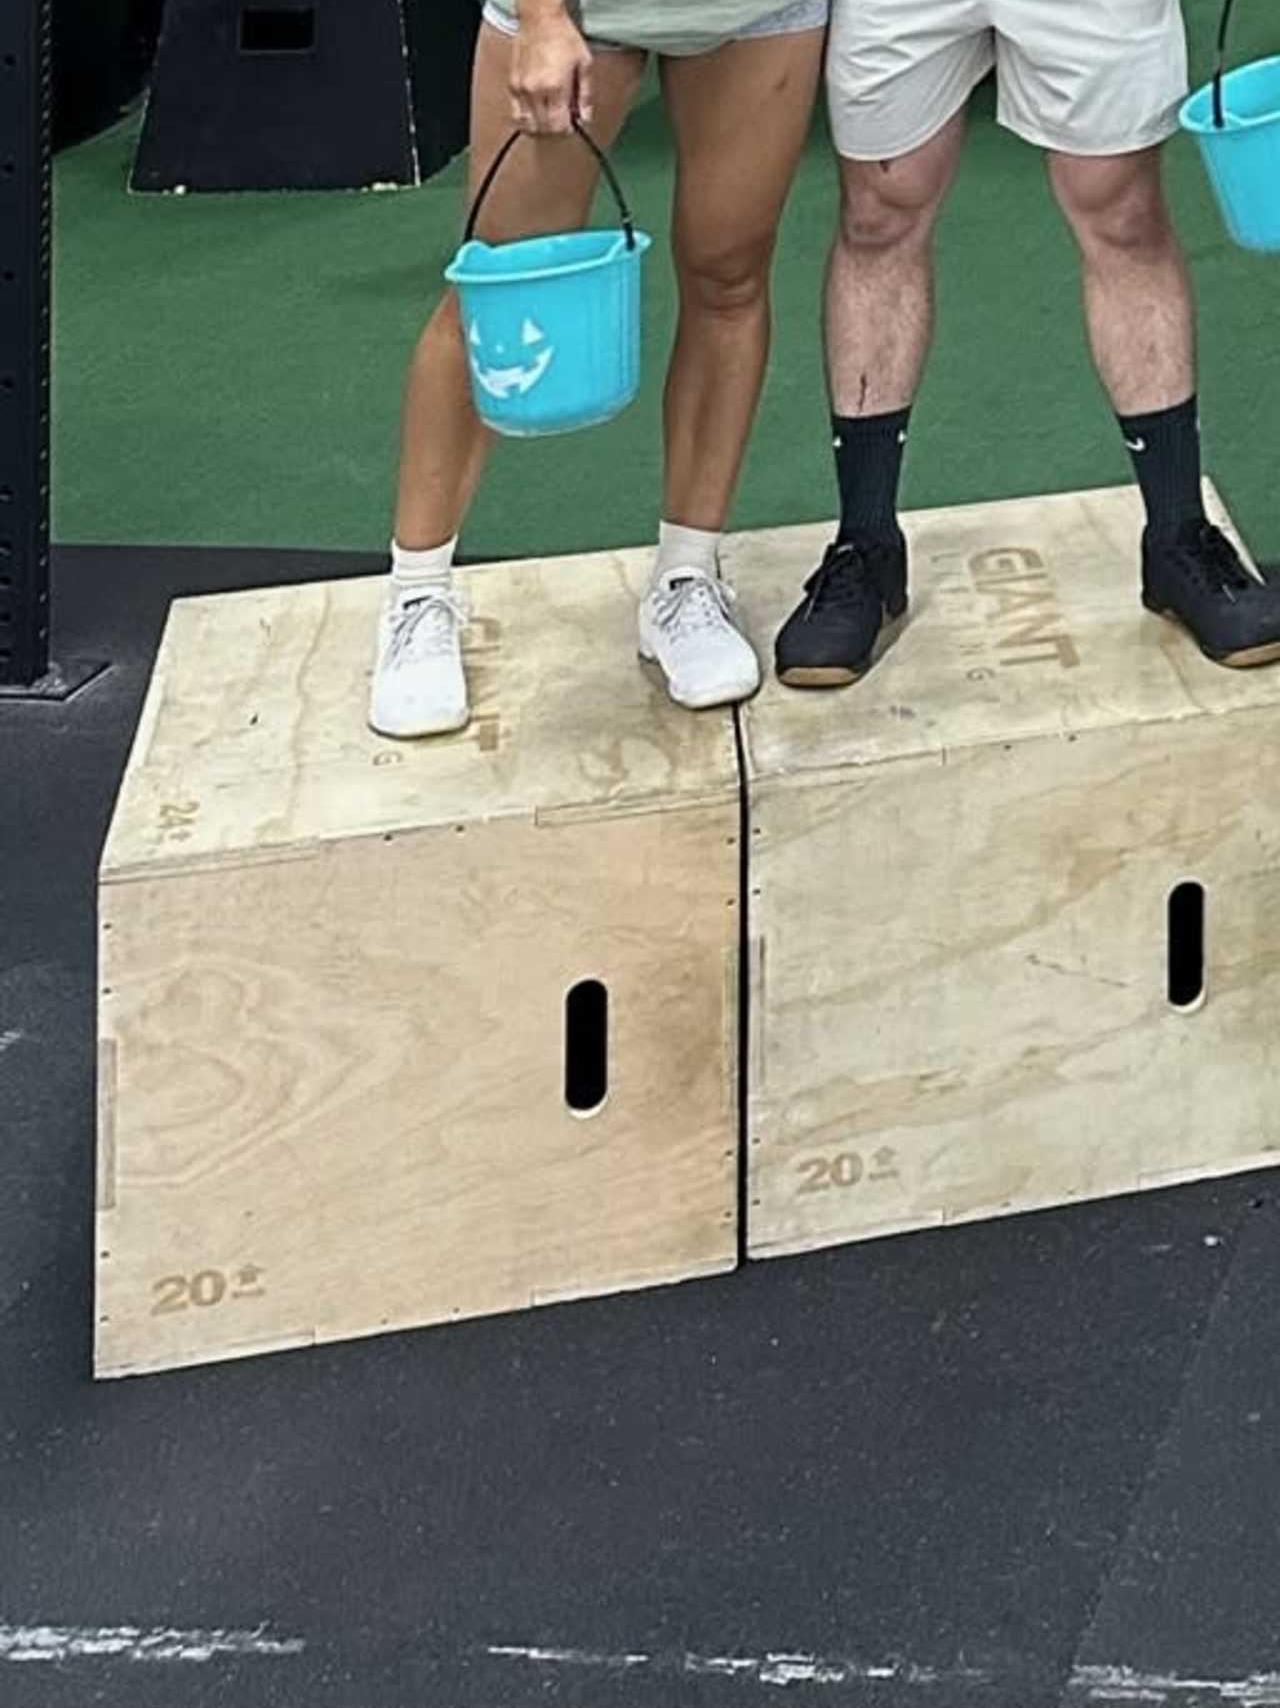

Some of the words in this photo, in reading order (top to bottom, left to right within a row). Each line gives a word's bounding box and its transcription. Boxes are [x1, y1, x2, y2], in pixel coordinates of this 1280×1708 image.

[968, 547, 1081, 669] GIANT
[796, 1151, 864, 1196] 20
[150, 1269, 228, 1316] 20
